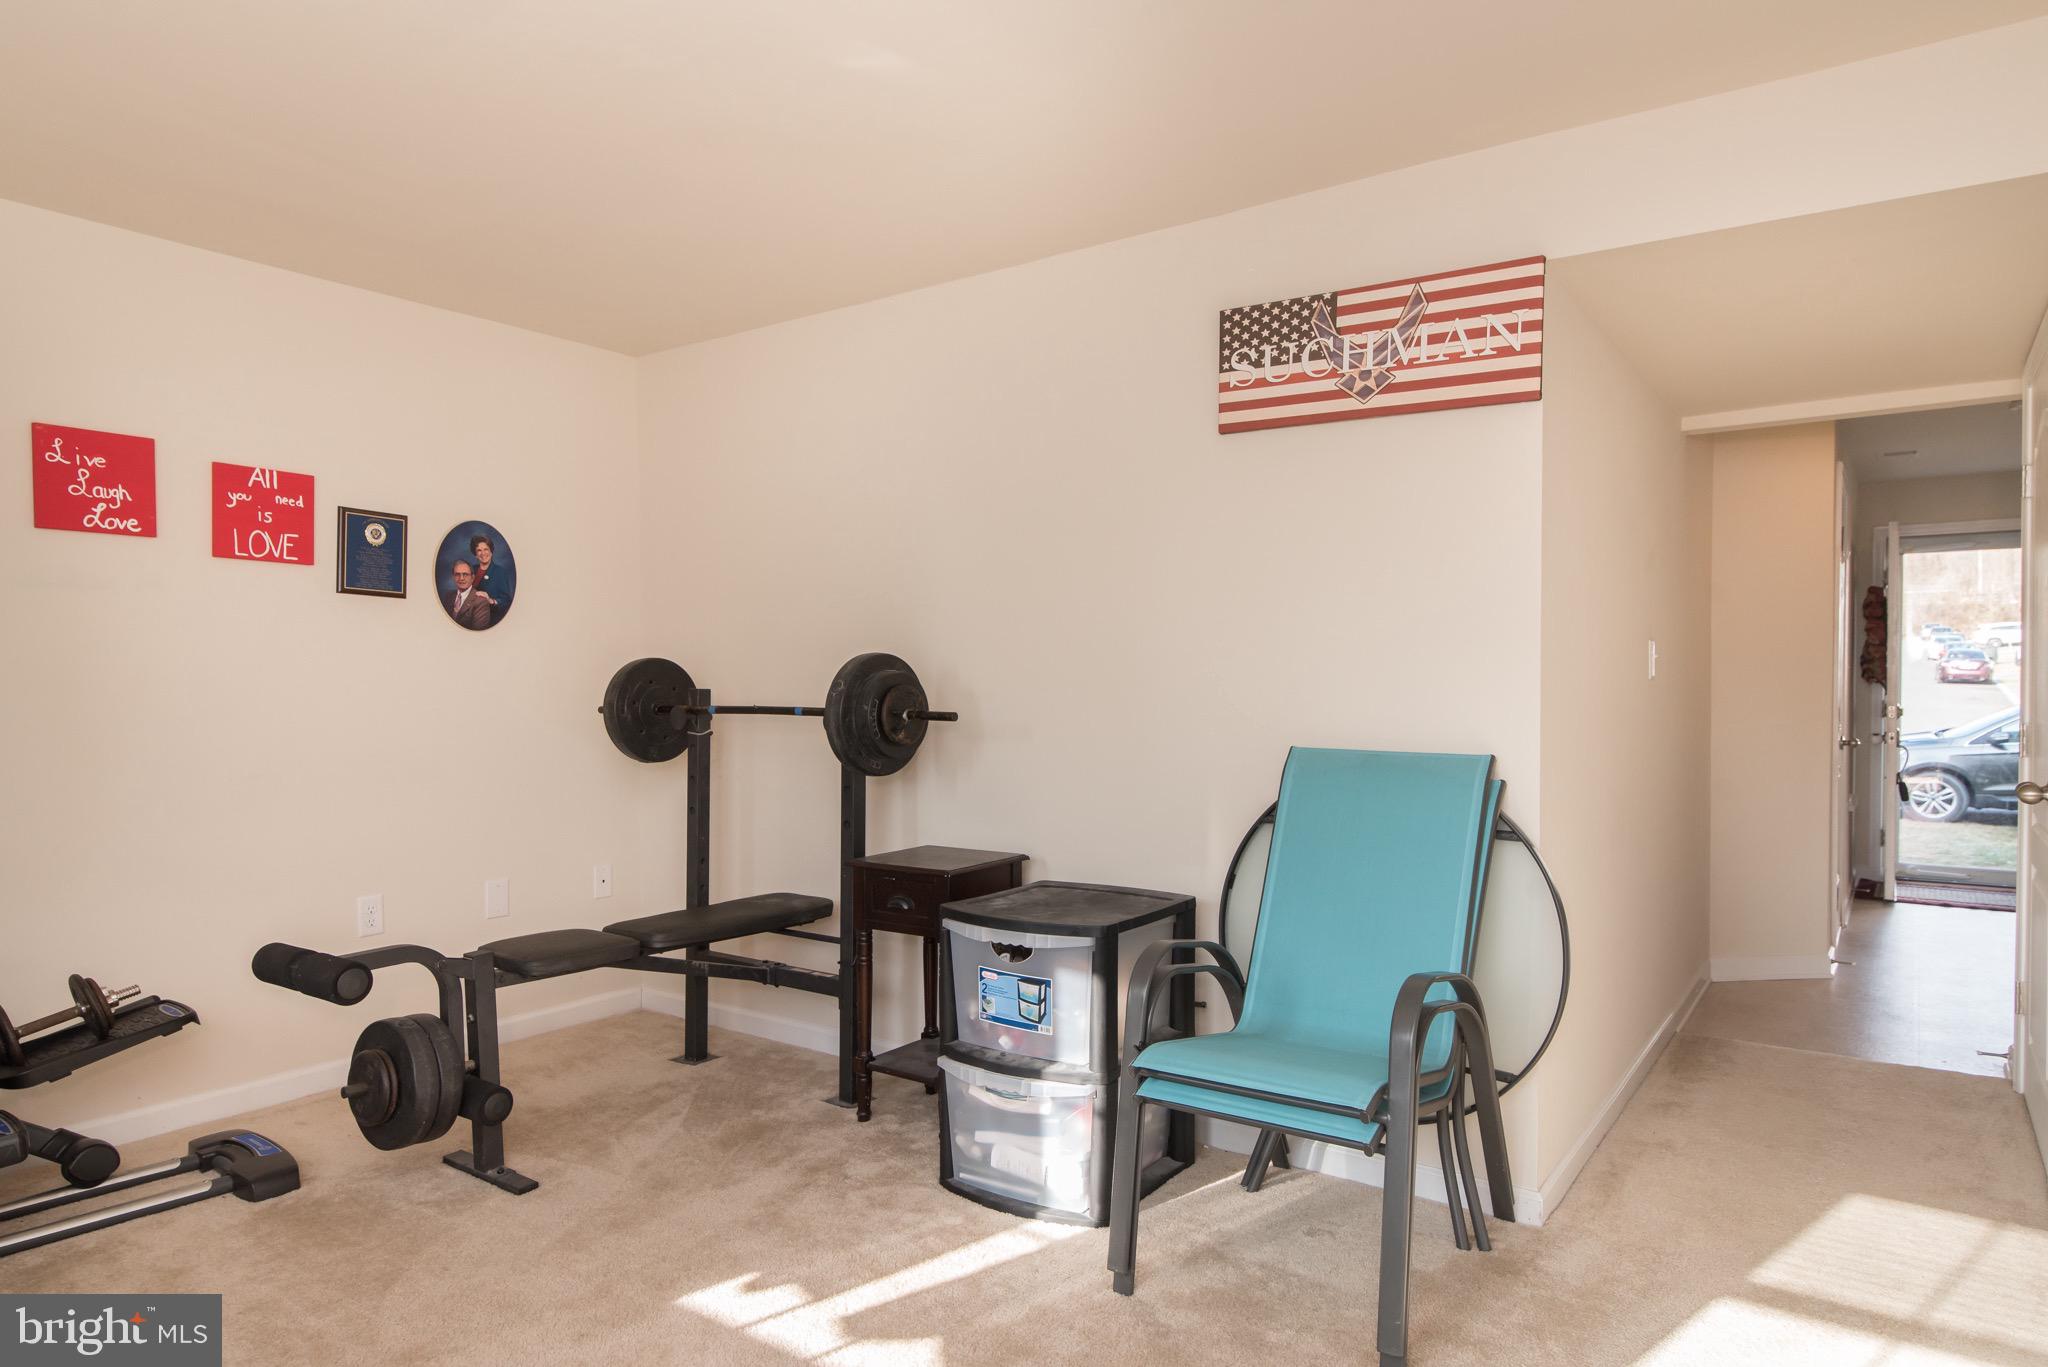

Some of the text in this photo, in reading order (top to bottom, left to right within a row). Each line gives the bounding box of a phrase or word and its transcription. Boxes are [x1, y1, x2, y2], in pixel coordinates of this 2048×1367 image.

[1229, 308, 1533, 388] SUCHMAN
[45, 437, 106, 468] Live
[68, 468, 132, 509] Laugh
[248, 467, 278, 489] All
[226, 491, 304, 508] you need
[258, 505, 273, 523] is
[83, 502, 142, 532] Love
[233, 528, 299, 560] LOVE
[981, 983, 988, 994] 2
